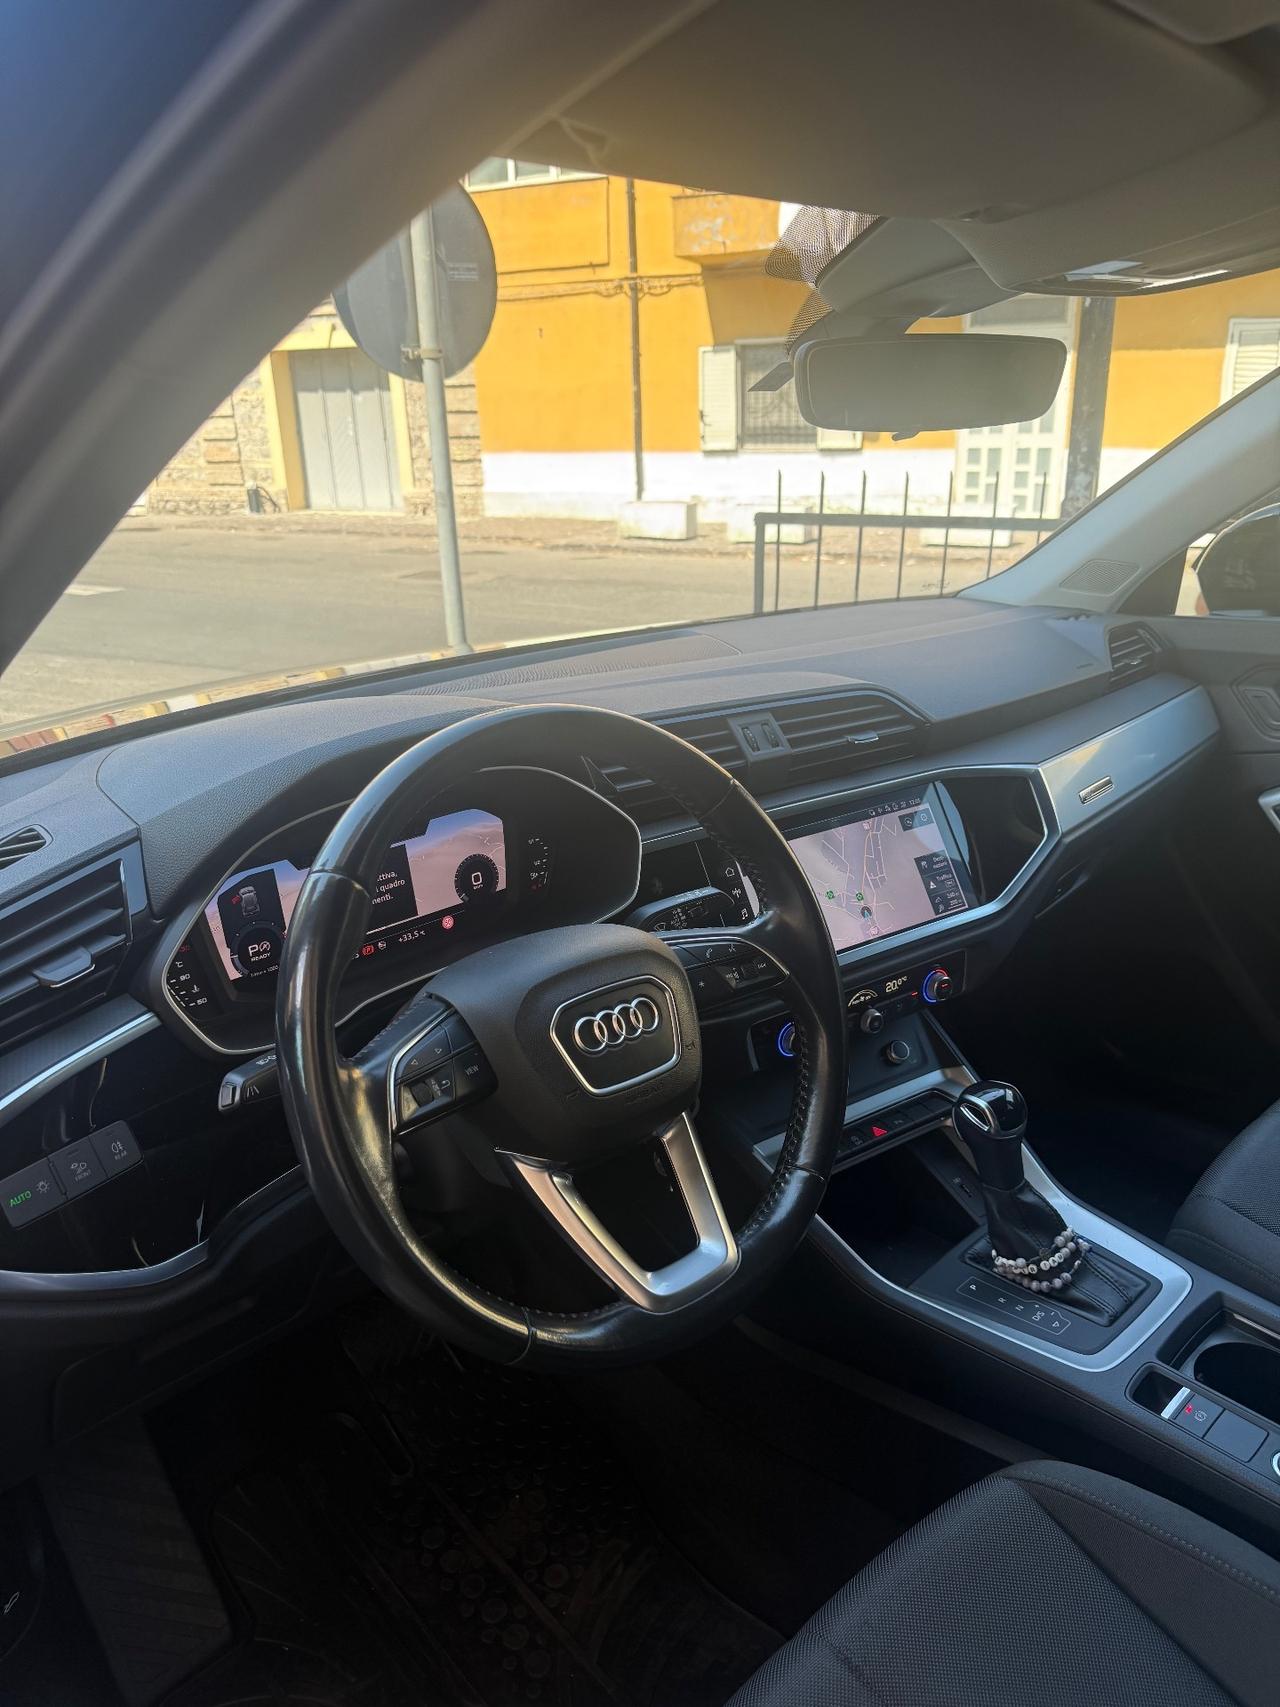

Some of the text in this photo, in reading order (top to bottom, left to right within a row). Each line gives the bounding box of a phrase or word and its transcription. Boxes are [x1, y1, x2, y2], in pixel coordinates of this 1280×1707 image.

[379, 879, 406, 893] quadro
[250, 952, 271, 963] READY
[179, 973, 191, 982] 90
[9, 1190, 32, 1208] AUTO
